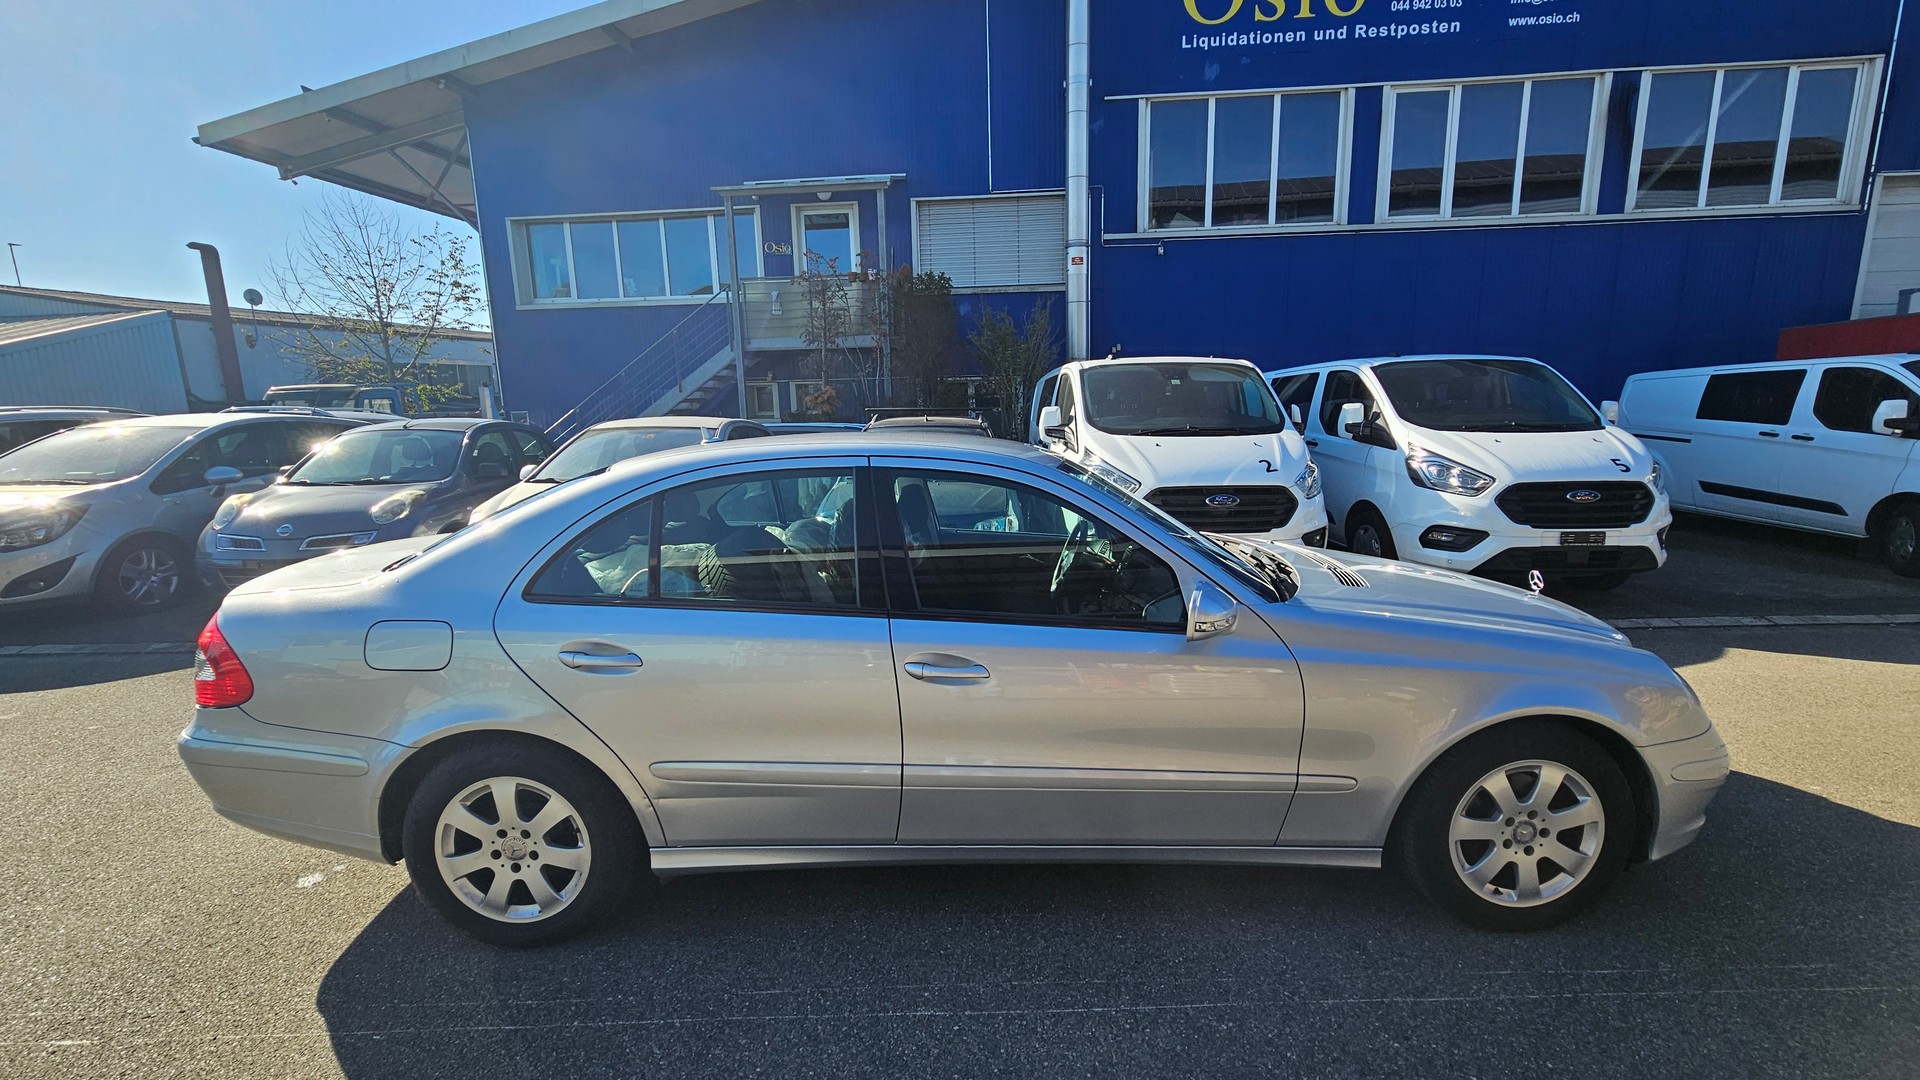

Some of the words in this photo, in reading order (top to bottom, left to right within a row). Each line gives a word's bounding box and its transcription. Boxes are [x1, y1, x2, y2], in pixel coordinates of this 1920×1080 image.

[1391, 0, 1410, 12] 044
[1412, 0, 1431, 10] 942
[1434, 0, 1447, 9] 03
[1449, 0, 1463, 8] 03
[1509, 11, 1580, 26] www.osio.ch
[1181, 31, 1306, 50] Liquidationen
[1314, 25, 1347, 41] und
[1355, 20, 1461, 39] Restposten
[764, 241, 791, 253] Osio
[1258, 459, 1279, 473] 2
[1610, 458, 1631, 473] 5
